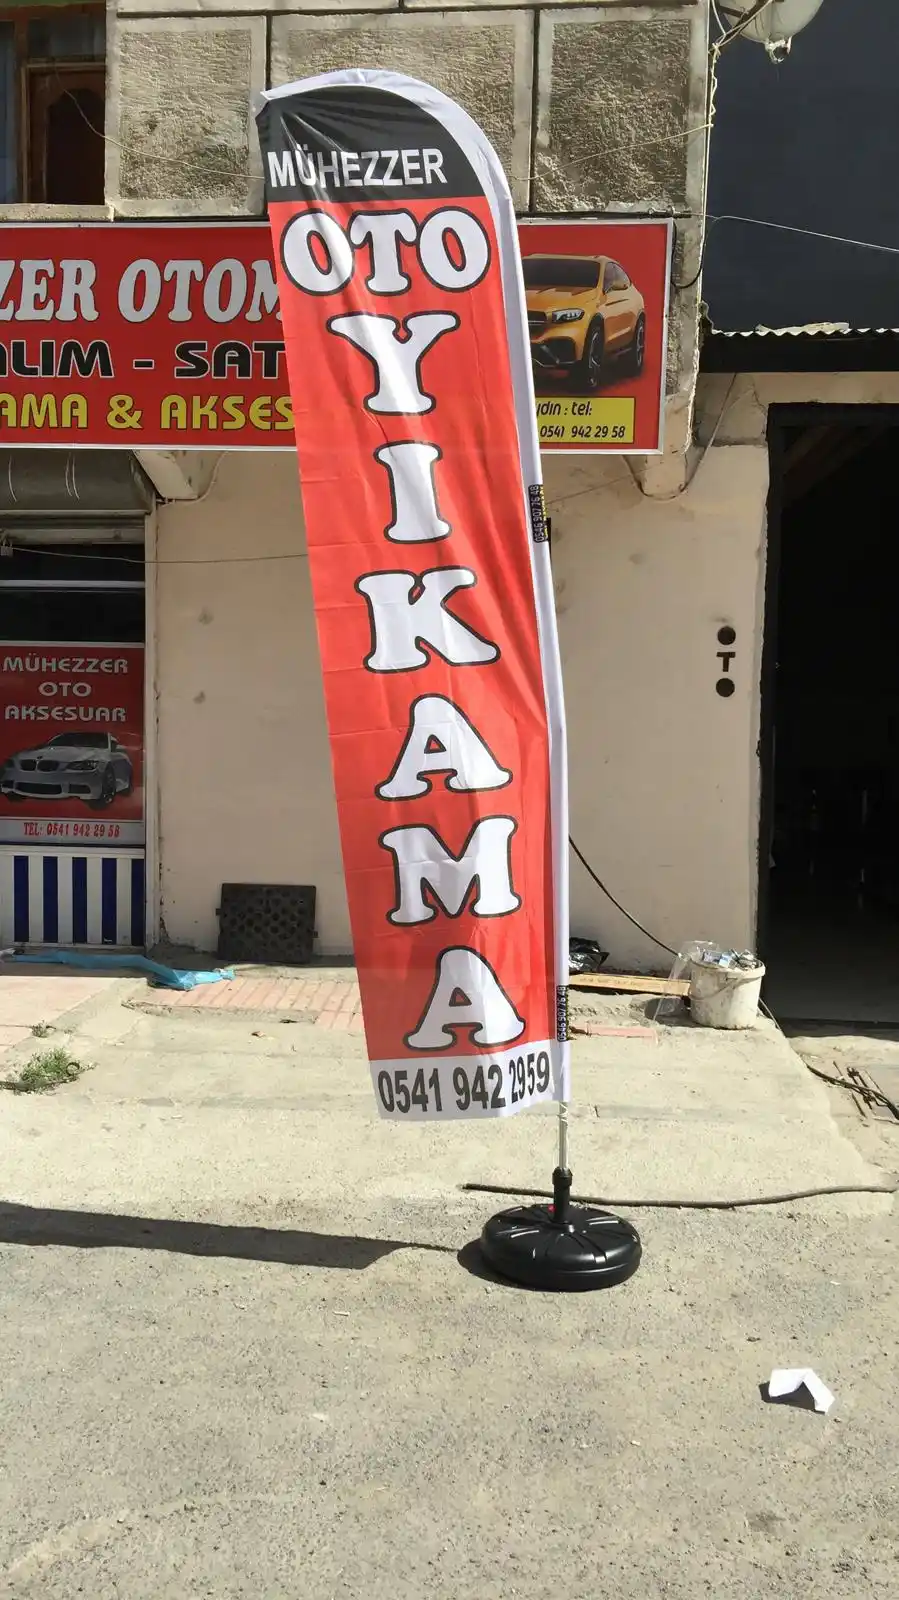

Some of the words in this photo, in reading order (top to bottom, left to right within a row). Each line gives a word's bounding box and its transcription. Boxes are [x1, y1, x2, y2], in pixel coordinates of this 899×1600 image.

[267, 144, 448, 187] MÜHEZZER
[280, 206, 491, 296] OTO
[0, 339, 114, 378] LIM
[174, 341, 287, 379] SAT
[106, 394, 143, 430] &
[160, 395, 295, 430] AKSES
[540, 425, 565, 438] 0541
[571, 425, 592, 438] 942
[594, 425, 608, 438] 29
[611, 425, 626, 438] 58
[3, 652, 128, 673] MÜHEZZER
[326, 310, 526, 1050] YIKAMA
[38, 681, 92, 697] OTO
[5, 705, 126, 722] AKSESUAR
[24, 822, 42, 836] TEL:
[47, 822, 69, 836] 0541
[73, 823, 90, 837] 942
[93, 824, 105, 837] 29
[378, 1068, 442, 1113] 0541
[453, 1064, 506, 1111] 942
